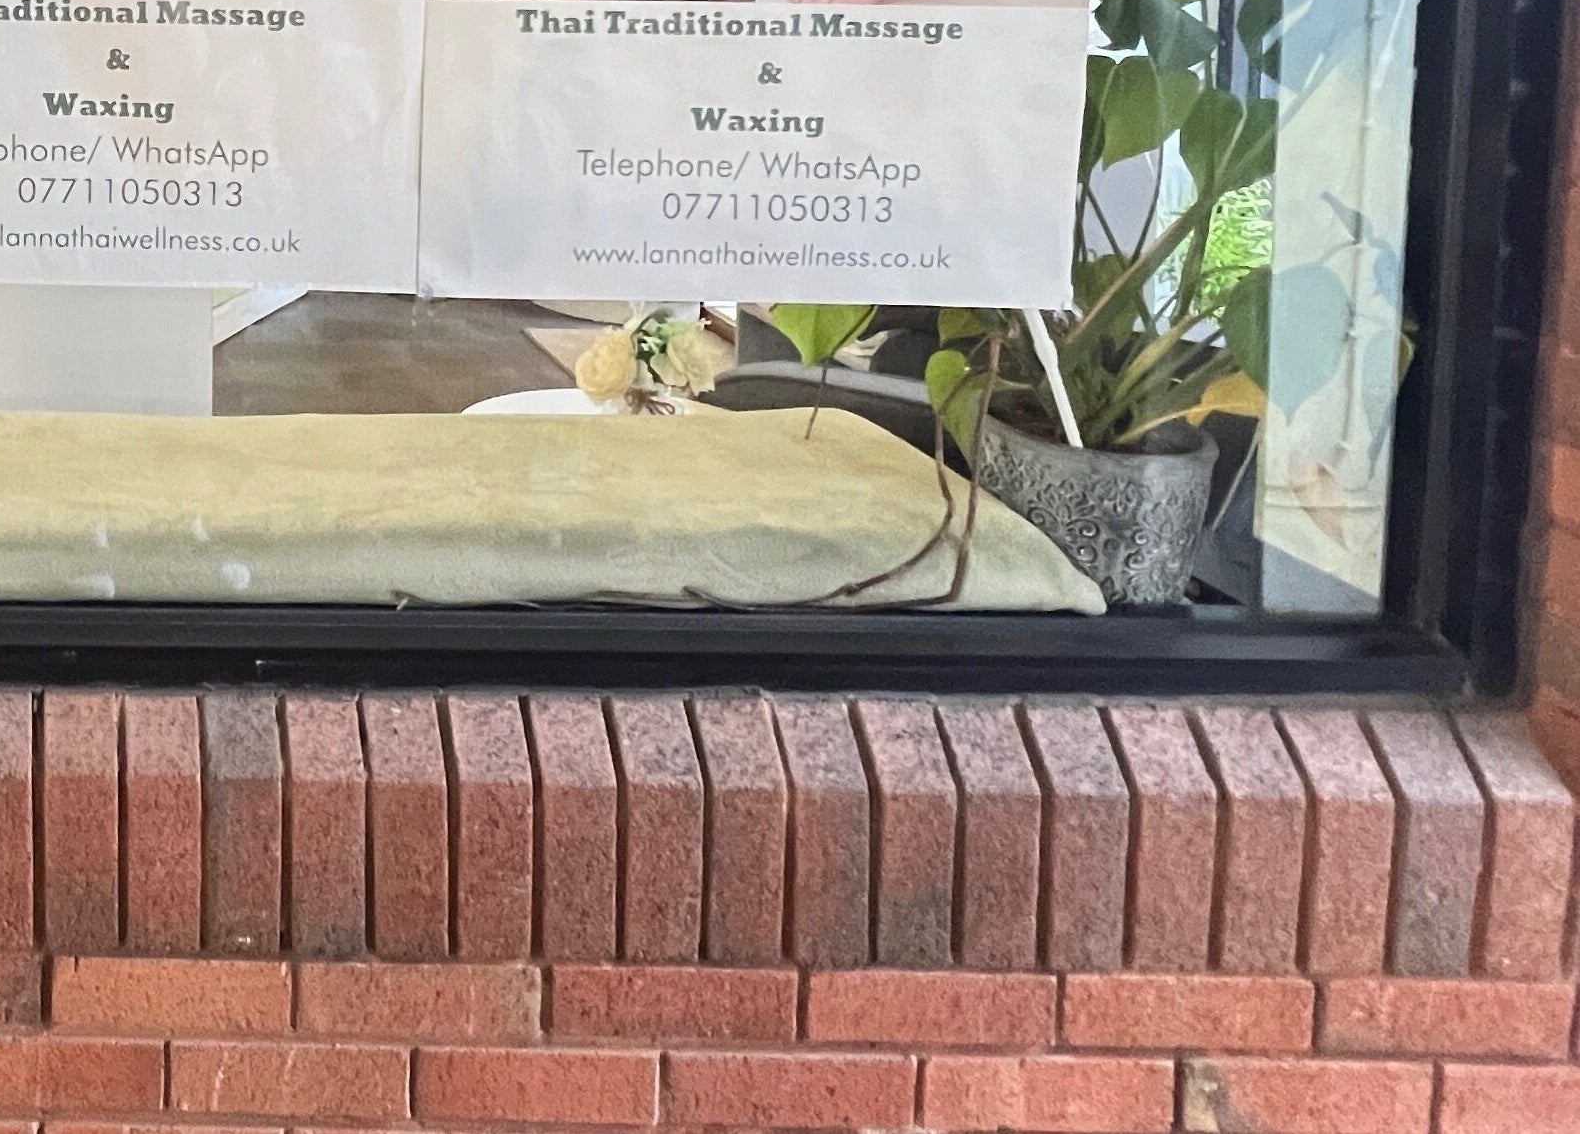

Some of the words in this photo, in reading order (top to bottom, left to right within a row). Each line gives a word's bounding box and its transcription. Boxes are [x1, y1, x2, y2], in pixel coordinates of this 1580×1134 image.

[155, 0, 307, 32] Massage
[516, 8, 596, 35] Thai
[604, 9, 802, 38] Traditional
[808, 12, 964, 45] Massage
[106, 48, 131, 71] &
[757, 62, 783, 85] &
[42, 92, 176, 124] Waxing
[690, 106, 825, 138] Waxing
[111, 135, 270, 173] WhatsApp
[576, 148, 751, 183] Telephone/
[759, 151, 921, 188] WhatsApp
[17, 177, 244, 208] 07711050313
[662, 192, 893, 224] 07711050313
[573, 240, 951, 270] www.lannathaiwellness.co.uk
